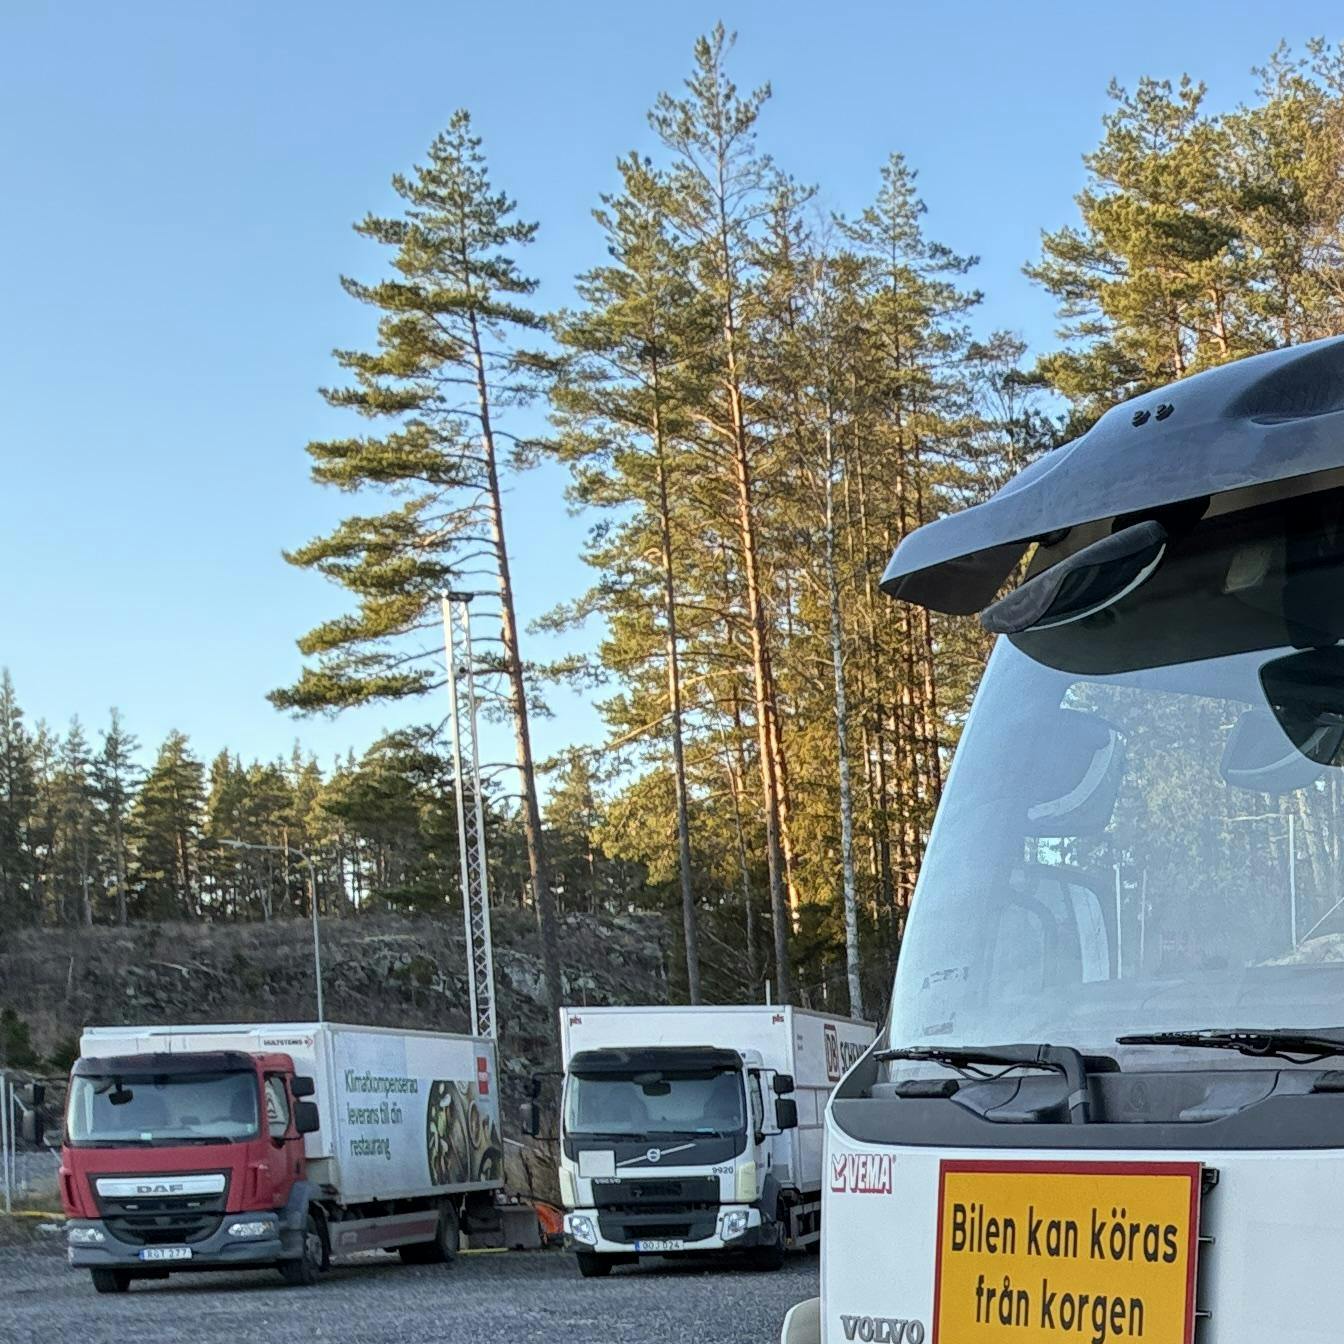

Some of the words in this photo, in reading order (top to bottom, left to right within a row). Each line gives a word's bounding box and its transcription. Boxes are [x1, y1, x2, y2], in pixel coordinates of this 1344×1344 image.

[136, 1184, 183, 1194] DAF
[848, 1154, 893, 1194] VEMA
[951, 1203, 1016, 1255] Bilen
[1027, 1205, 1078, 1259] kan
[1090, 1207, 1178, 1264] köras
[975, 1274, 1029, 1327] från
